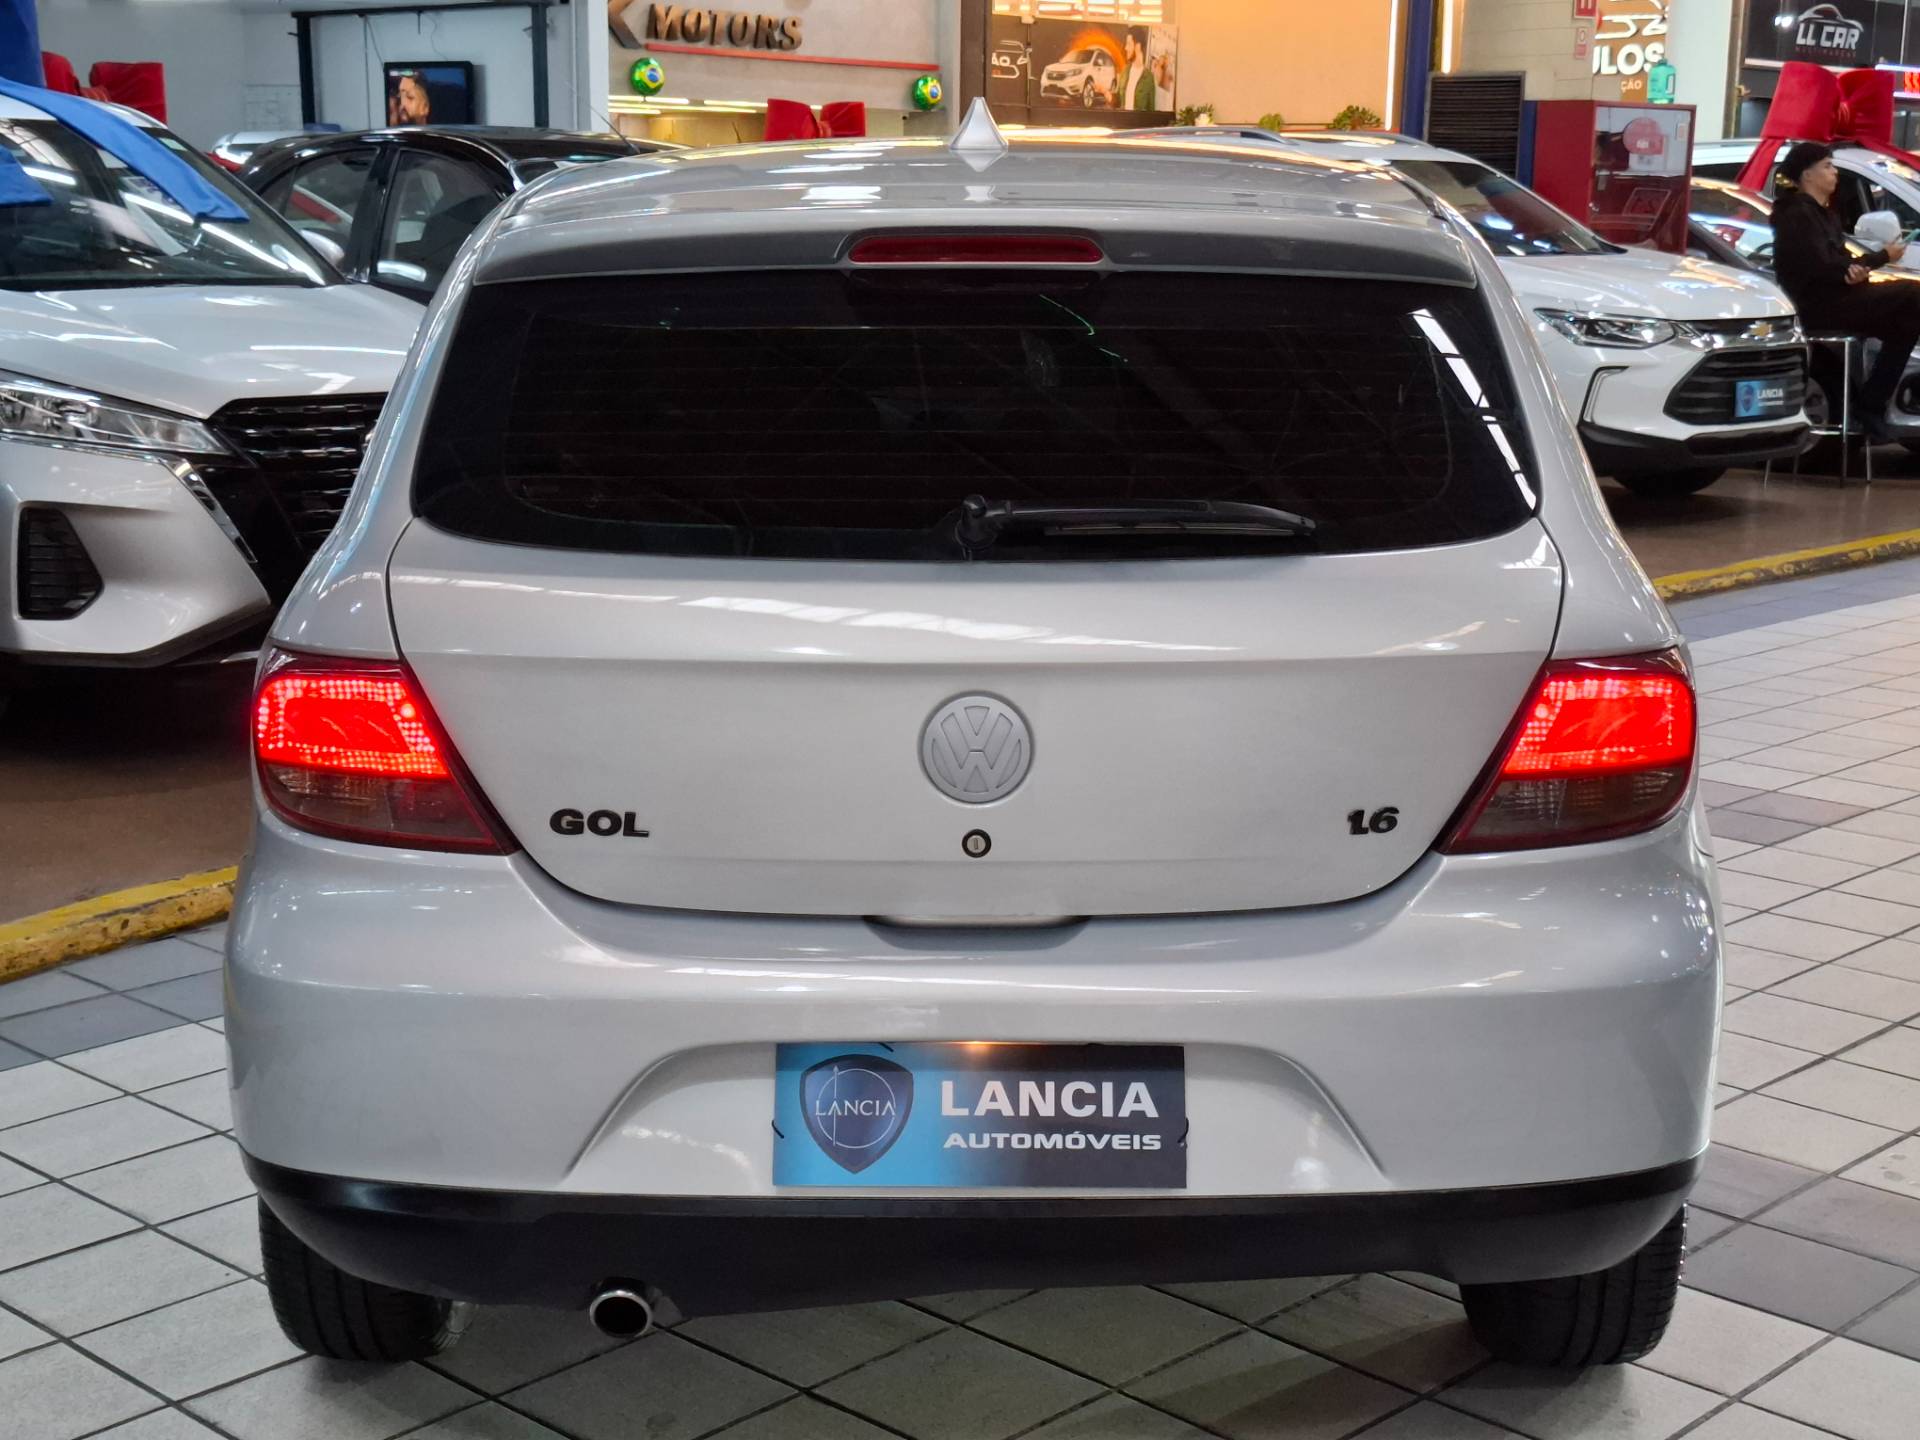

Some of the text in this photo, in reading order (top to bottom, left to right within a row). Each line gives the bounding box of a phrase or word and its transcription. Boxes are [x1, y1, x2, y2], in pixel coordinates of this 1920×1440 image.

[646, 3, 802, 50] MOTORS
[1796, 23, 1860, 50] LL CAR
[549, 808, 650, 838] GOL
[815, 1099, 896, 1116] LANCIA
[941, 1080, 1159, 1118] LANCIA
[943, 1130, 1162, 1151] AUTOMÓVEIS
